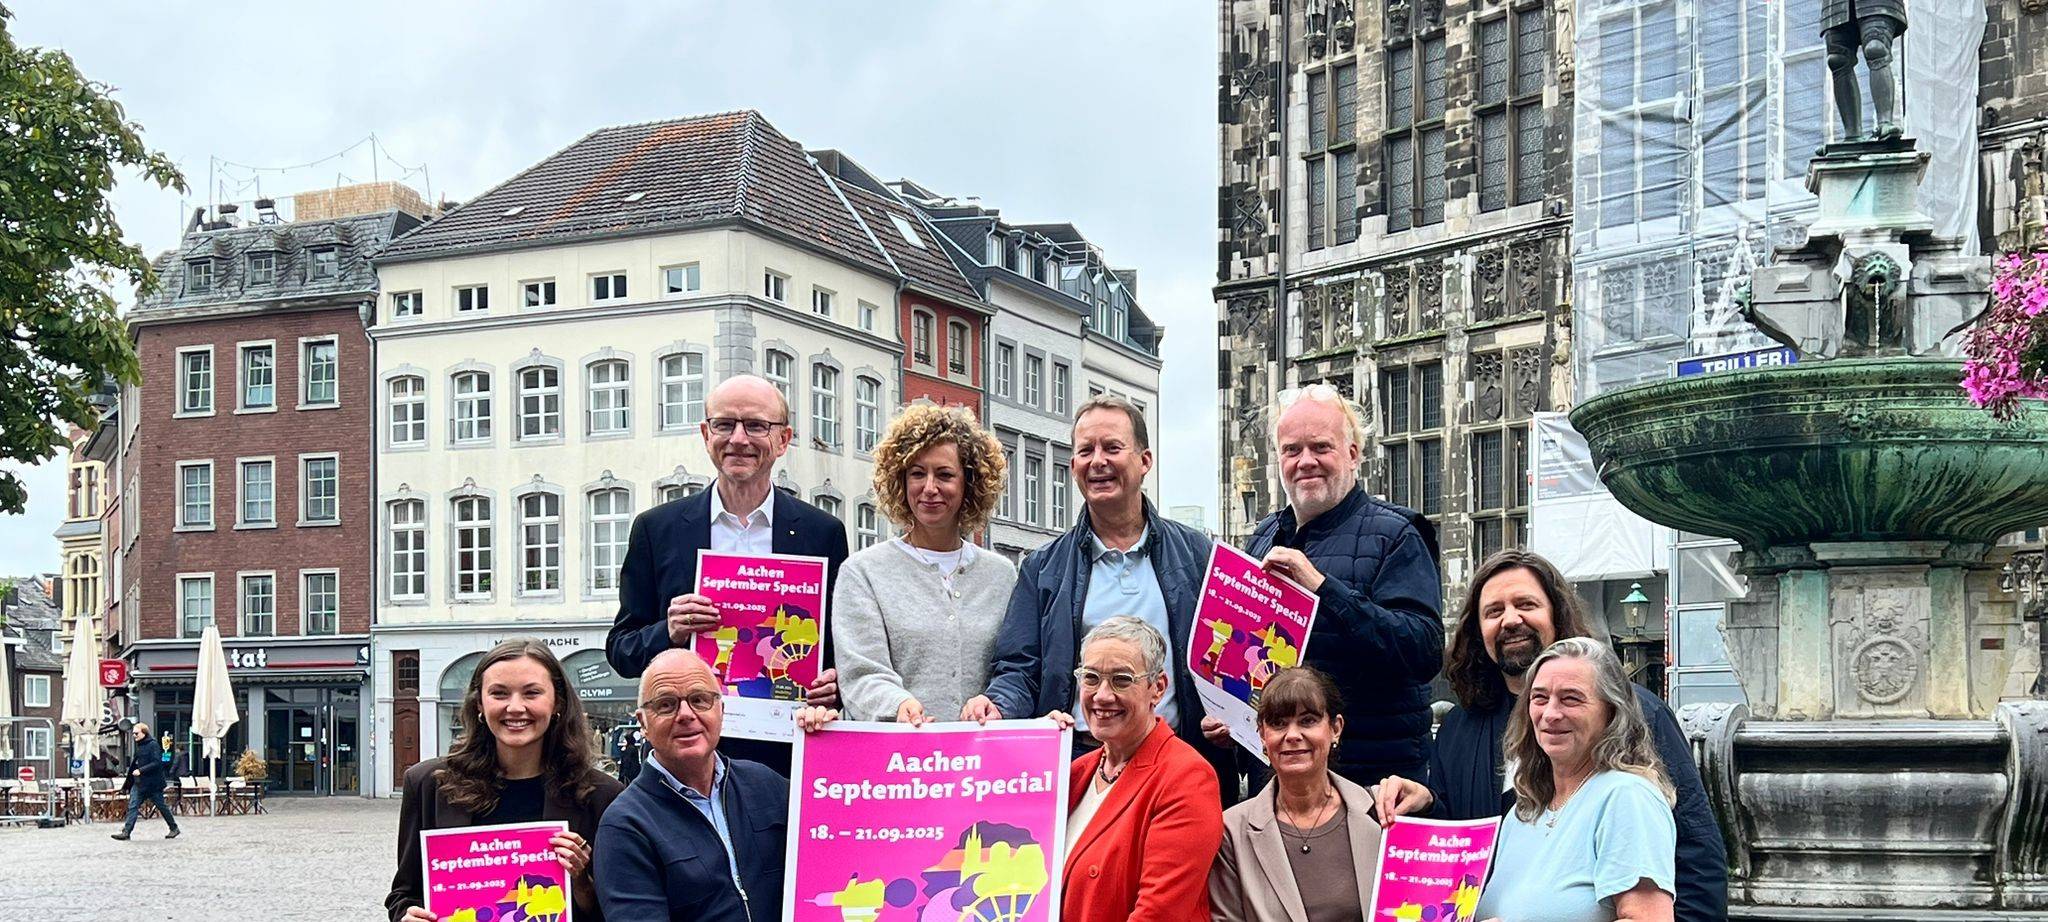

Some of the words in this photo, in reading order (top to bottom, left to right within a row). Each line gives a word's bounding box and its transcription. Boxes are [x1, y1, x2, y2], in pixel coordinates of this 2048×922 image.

[737, 565, 785, 579] Aachen
[702, 576, 771, 592] September
[773, 581, 820, 596] Special
[1243, 569, 1283, 599] Aachen
[1213, 566, 1269, 604] September
[1270, 598, 1308, 628] Special
[721, 602, 767, 613] 21.09.2025
[580, 688, 613, 698] OLYMP
[886, 750, 982, 774] Aachen
[813, 777, 955, 806] September
[960, 770, 1054, 802] Special
[809, 824, 835, 841] 18.
[854, 825, 945, 844] 21.09.2025
[1428, 834, 1472, 847] Aachen
[470, 839, 521, 853] Aachen
[1388, 845, 1460, 862] September
[431, 854, 507, 872] September
[510, 849, 558, 866] Specia
[432, 883, 446, 892] 18.
[457, 880, 506, 890] 21.09.2025
